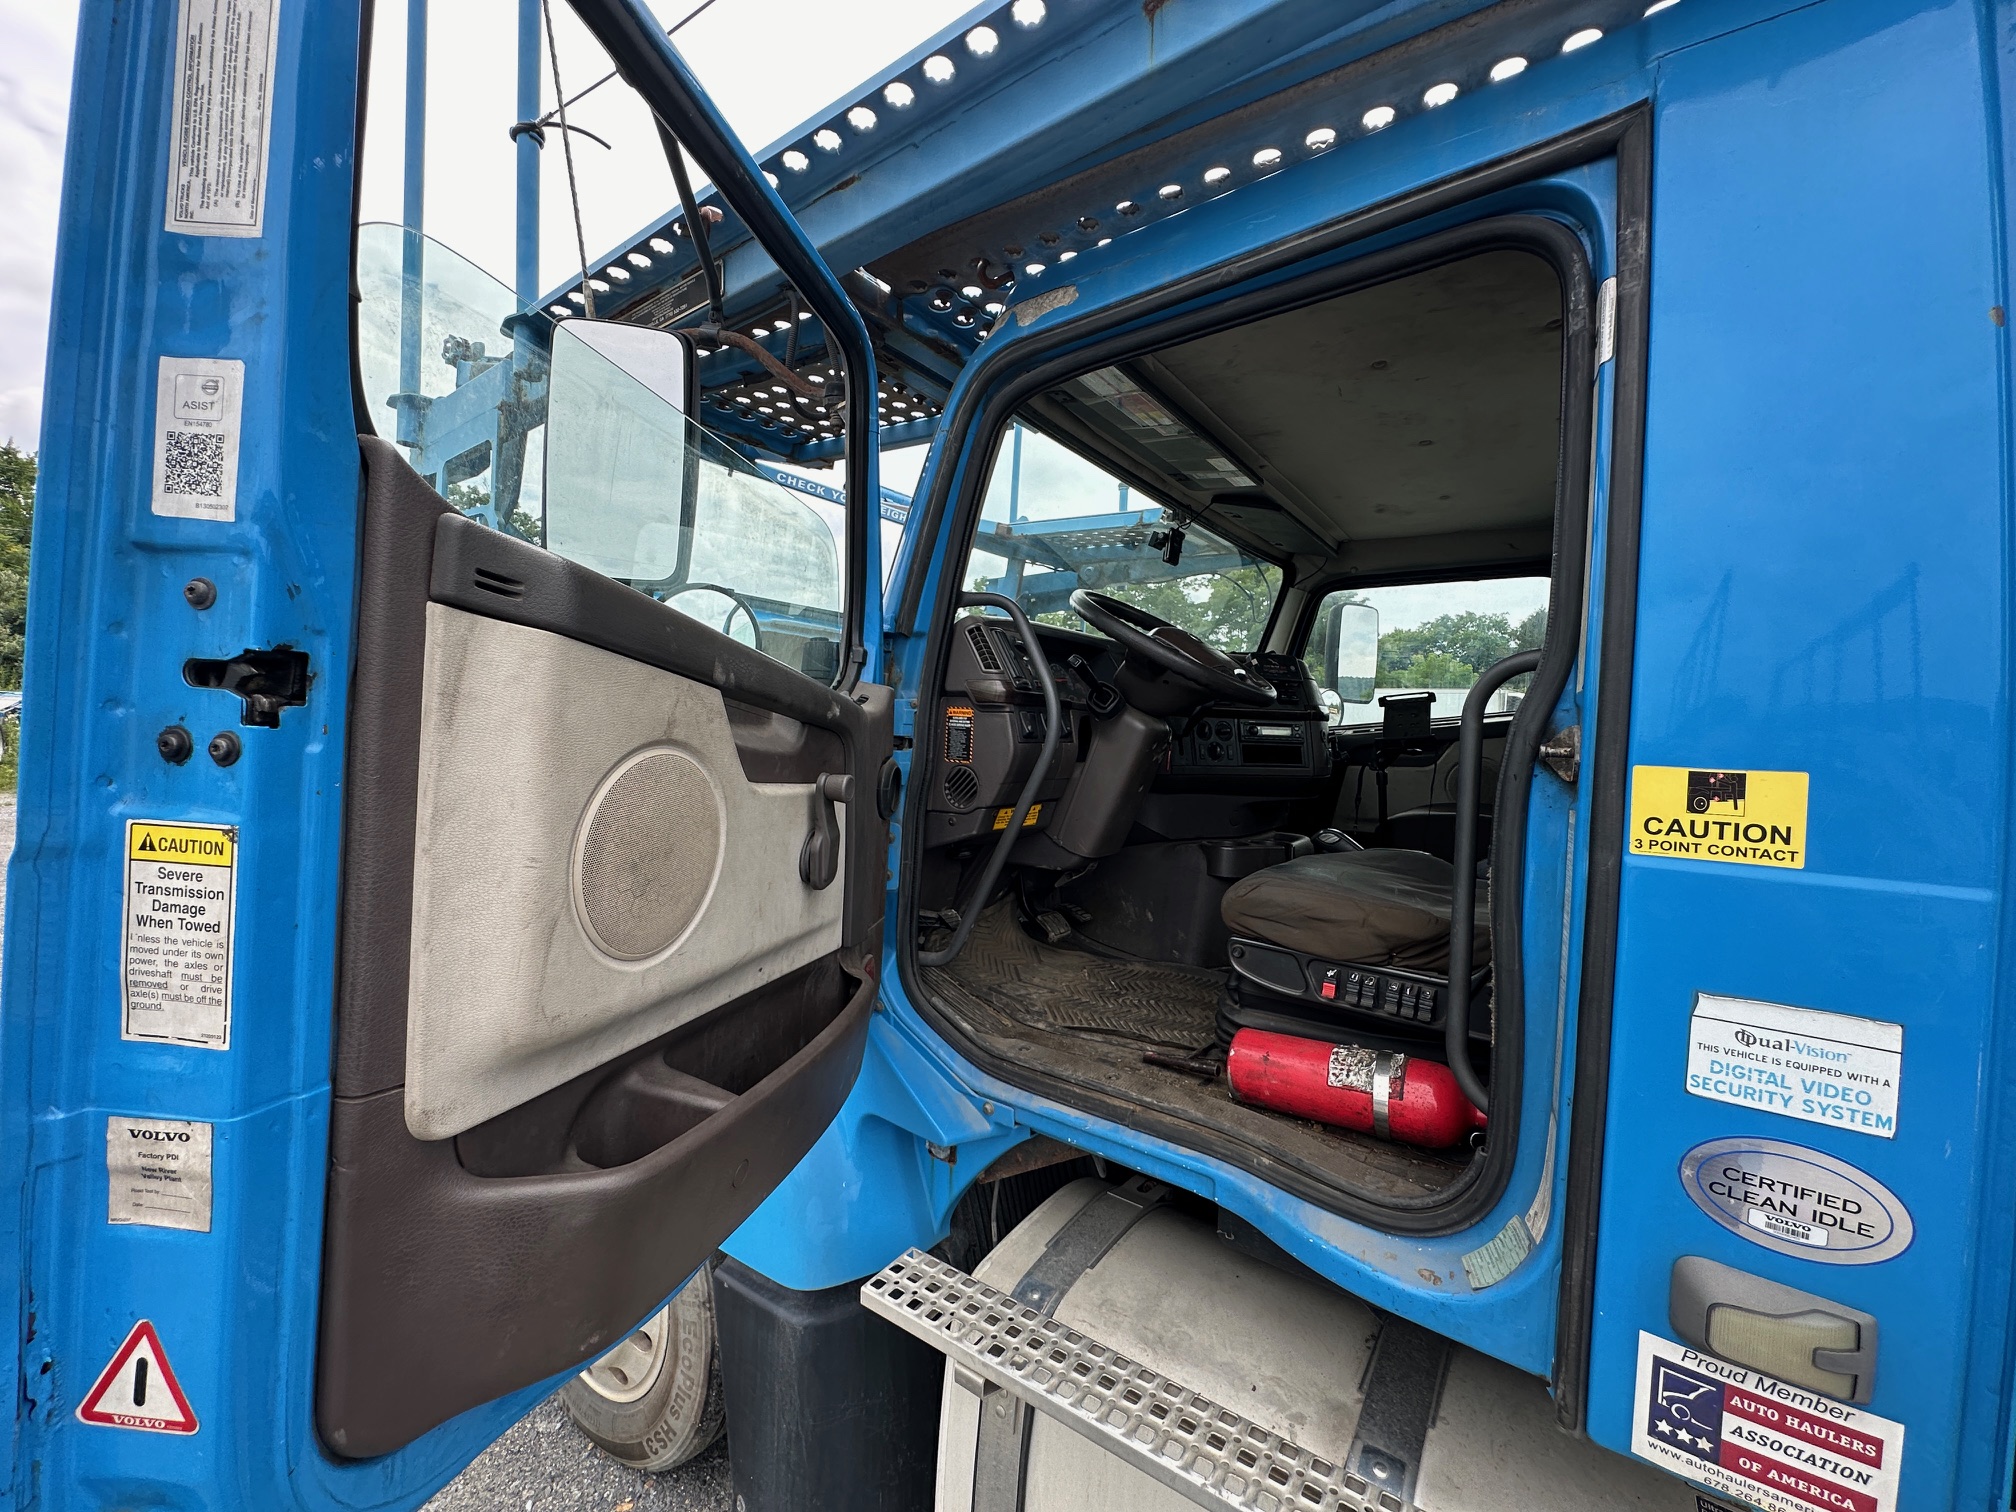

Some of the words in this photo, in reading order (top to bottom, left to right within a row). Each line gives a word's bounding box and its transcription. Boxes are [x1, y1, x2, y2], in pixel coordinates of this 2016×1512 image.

[182, 400, 215, 411] ASIST
[776, 472, 826, 495] CHECK
[832, 490, 845, 503] YO
[1643, 816, 1792, 845] CAUTION
[158, 837, 224, 856] CAUTION
[1634, 838, 1643, 849] 3
[1649, 839, 1702, 854] POINT
[1707, 844, 1799, 862] CONTACT
[157, 866, 203, 883] Severe
[134, 881, 225, 901] Transmission
[152, 899, 206, 918] Damage
[136, 914, 173, 929] When
[177, 917, 221, 934] Towed
[164, 936, 179, 945] the
[182, 938, 213, 948] vehicle
[216, 941, 224, 949] is
[129, 946, 159, 955] moved
[162, 948, 188, 958] under
[191, 950, 202, 959] its
[204, 952, 224, 960] own
[129, 957, 158, 967] power,
[164, 959, 179, 968] the
[184, 961, 208, 971] axles
[213, 964, 224, 972] or
[129, 968, 172, 979] driveshaft
[181, 972, 203, 982] must
[211, 974, 223, 983] be
[129, 979, 168, 989] removed
[201, 985, 223, 994] drive
[130, 990, 159, 1000] axle(s)
[161, 992, 182, 1001] must
[184, 994, 194, 1003] be
[196, 996, 207, 1004] off
[208, 997, 223, 1006] the
[1697, 1042, 1720, 1054] THIS
[1723, 1047, 1768, 1064] VEHICLE
[1771, 1057, 1782, 1066] IS
[1785, 1060, 1843, 1078] EQUIPPED
[1846, 1071, 1880, 1086] WITH
[1882, 1079, 1891, 1088] A
[1709, 1059, 1793, 1090] DIGITAL
[1800, 1077, 1872, 1106] VIDEO
[1690, 1074, 1794, 1109] SECURITY
[1802, 1099, 1893, 1131] SYSTEM
[127, 1128, 191, 1143] VOLVO
[137, 1152, 164, 1161] Factory
[158, 1167, 177, 1175] River
[1722, 1167, 1863, 1215] CERTIFIED
[1708, 1181, 1798, 1217] CLEAN
[1811, 1209, 1875, 1239] IDLE
[1764, 1214, 1812, 1232] VOLVO
[1680, 1349, 1749, 1384] Proud
[1754, 1377, 1857, 1422] Member
[111, 1414, 166, 1429] VOLVO
[1730, 1395, 1779, 1422] AUTO
[1785, 1414, 1877, 1457] HAULERS
[645, 1419, 678, 1456] HS3
[1729, 1425, 1873, 1486] ASSOCIATION
[1738, 1457, 1763, 1473] OF
[1767, 1469, 1857, 1512] AMERICA
